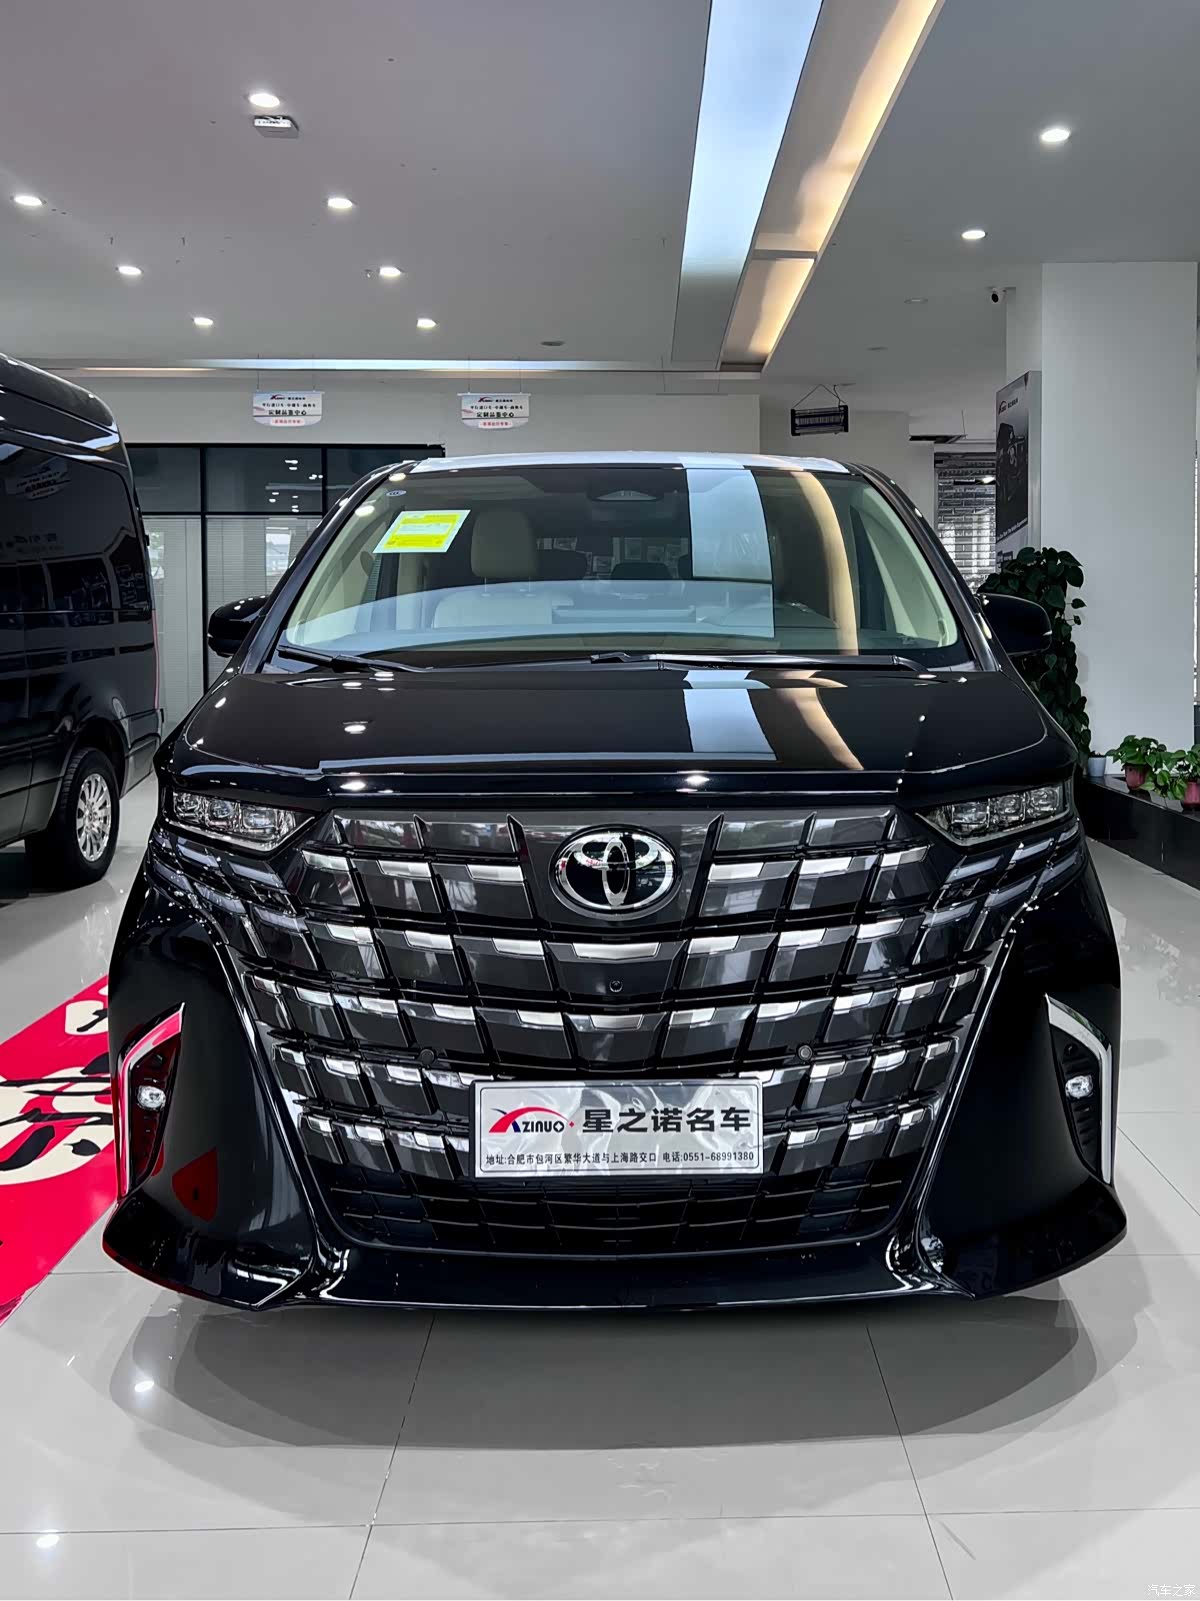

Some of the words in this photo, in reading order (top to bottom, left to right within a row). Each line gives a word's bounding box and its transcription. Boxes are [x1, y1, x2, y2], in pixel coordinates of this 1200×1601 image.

[582, 1106, 751, 1133] 星之诺名车
[485, 1151, 657, 1166] 地址:合肥市包河区繁华大道与上海路交口
[662, 1151, 754, 1163] 电话:0551-68991380
